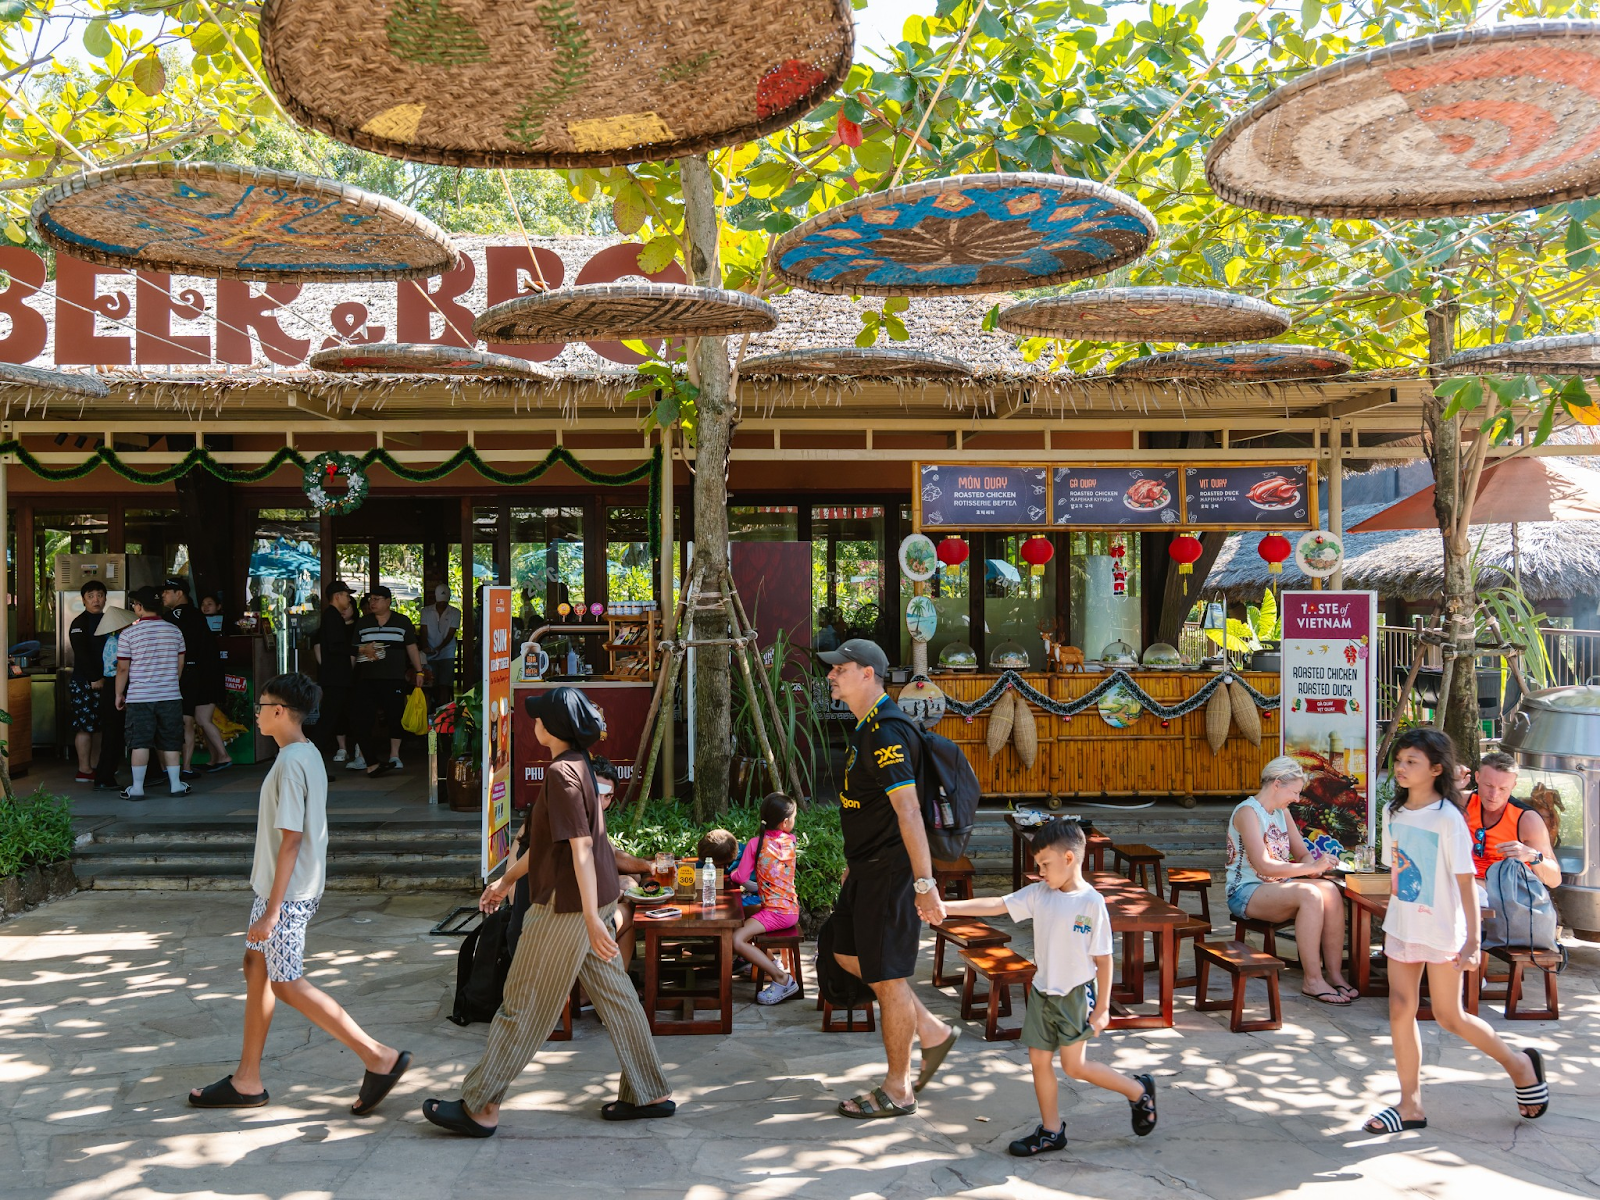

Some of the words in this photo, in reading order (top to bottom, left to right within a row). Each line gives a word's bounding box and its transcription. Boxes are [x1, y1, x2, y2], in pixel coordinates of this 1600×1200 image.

[321, 301, 386, 346] &
[958, 475, 980, 489] MÓN
[984, 477, 1008, 489] QUAY
[1080, 479, 1097, 488] QUAY
[1210, 479, 1227, 488] QUAY
[1340, 603, 1351, 617] of
[1297, 618, 1352, 629] VIETNAM
[493, 629, 507, 653] SUN
[1293, 667, 1324, 679] ROASTED
[1327, 668, 1357, 681] CHICKEN
[1298, 682, 1330, 696] ROASTED
[1332, 684, 1352, 697] DUCK
[525, 767, 544, 780] PHU
